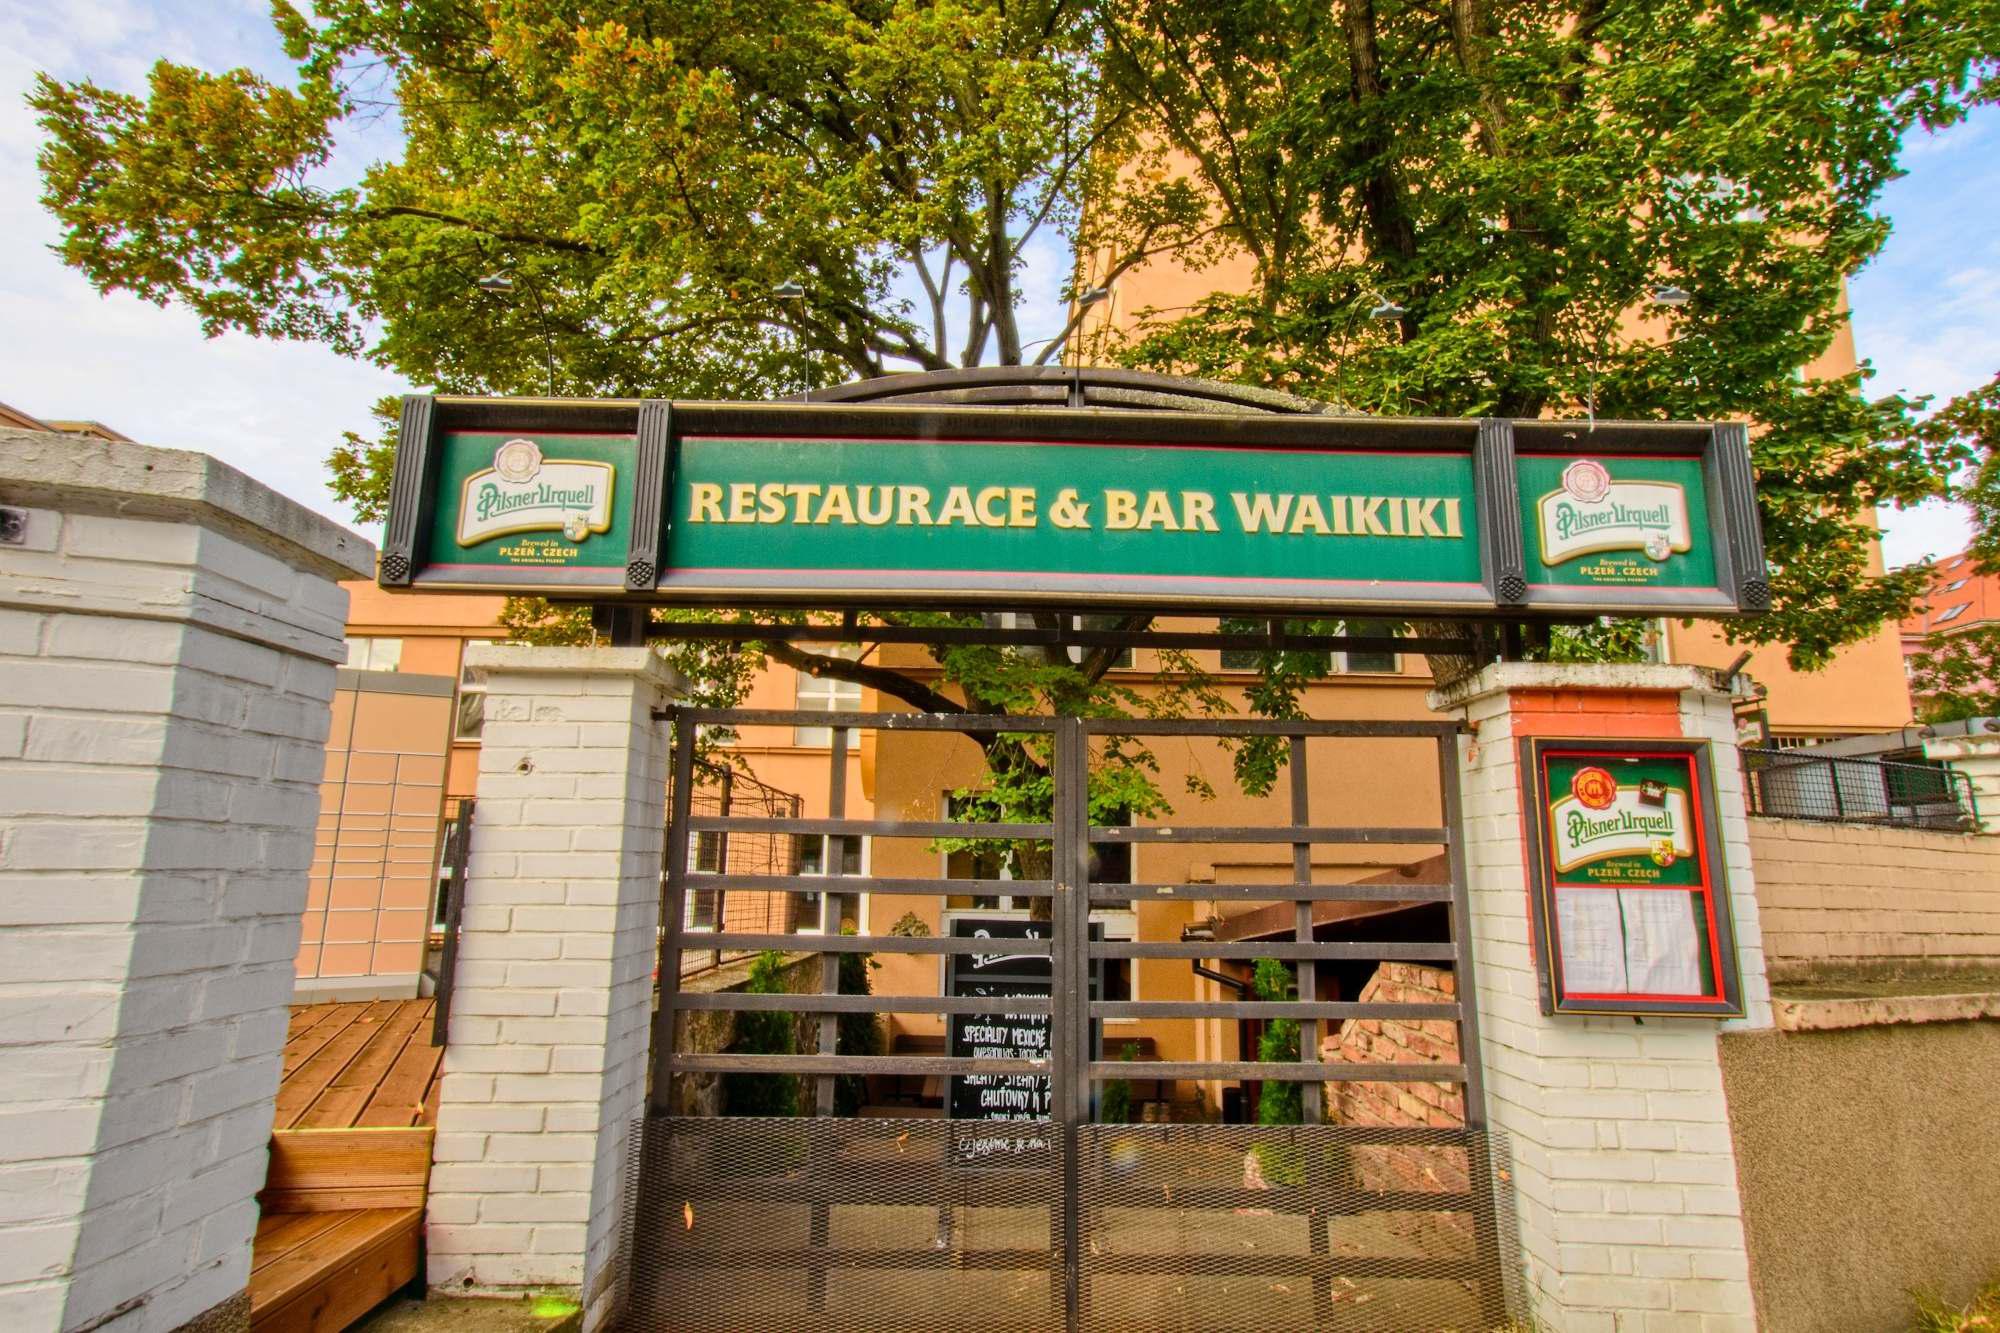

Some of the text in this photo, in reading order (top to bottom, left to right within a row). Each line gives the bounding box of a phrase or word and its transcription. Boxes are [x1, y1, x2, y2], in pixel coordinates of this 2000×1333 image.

[477, 482, 595, 522] Pilsner Urquell
[687, 481, 1463, 538] RESTAURACE & BAR WAIKIKI
[1555, 502, 1670, 540] Pilsner Urquell
[521, 539, 559, 547] Brewed in
[542, 548, 578, 557] CZECH
[1599, 558, 1637, 566] Brewed in
[1622, 567, 1659, 576] CZECH
[1567, 808, 1674, 848] Pilsner Urquell
[1627, 868, 1660, 878] CZECH
[963, 1025, 1008, 1044] SPECIALITY
[1012, 1027, 1047, 1049] MEXICKÉ
